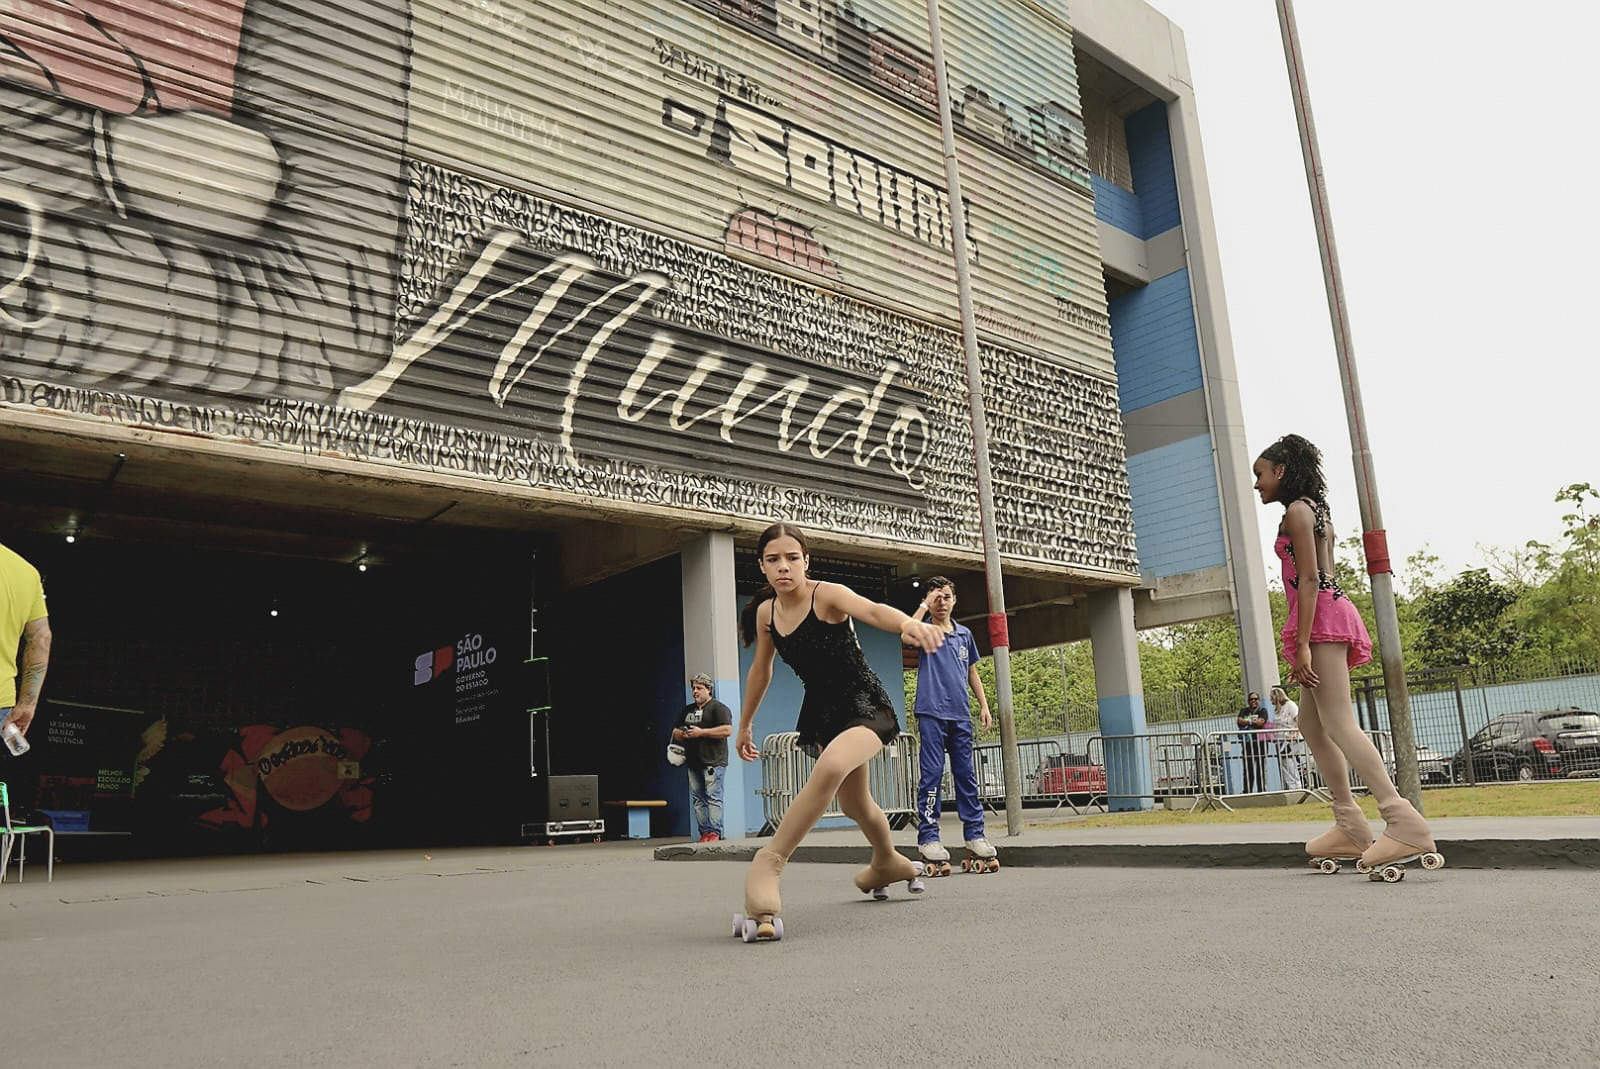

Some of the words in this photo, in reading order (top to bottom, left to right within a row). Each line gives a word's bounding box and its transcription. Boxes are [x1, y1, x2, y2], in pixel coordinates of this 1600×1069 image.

[335, 229, 932, 491] Mundo
[457, 633, 482, 656] SÃO
[456, 647, 497, 673] PAULO
[456, 670, 486, 684] GOVERNO
[465, 678, 489, 690] ESTADO
